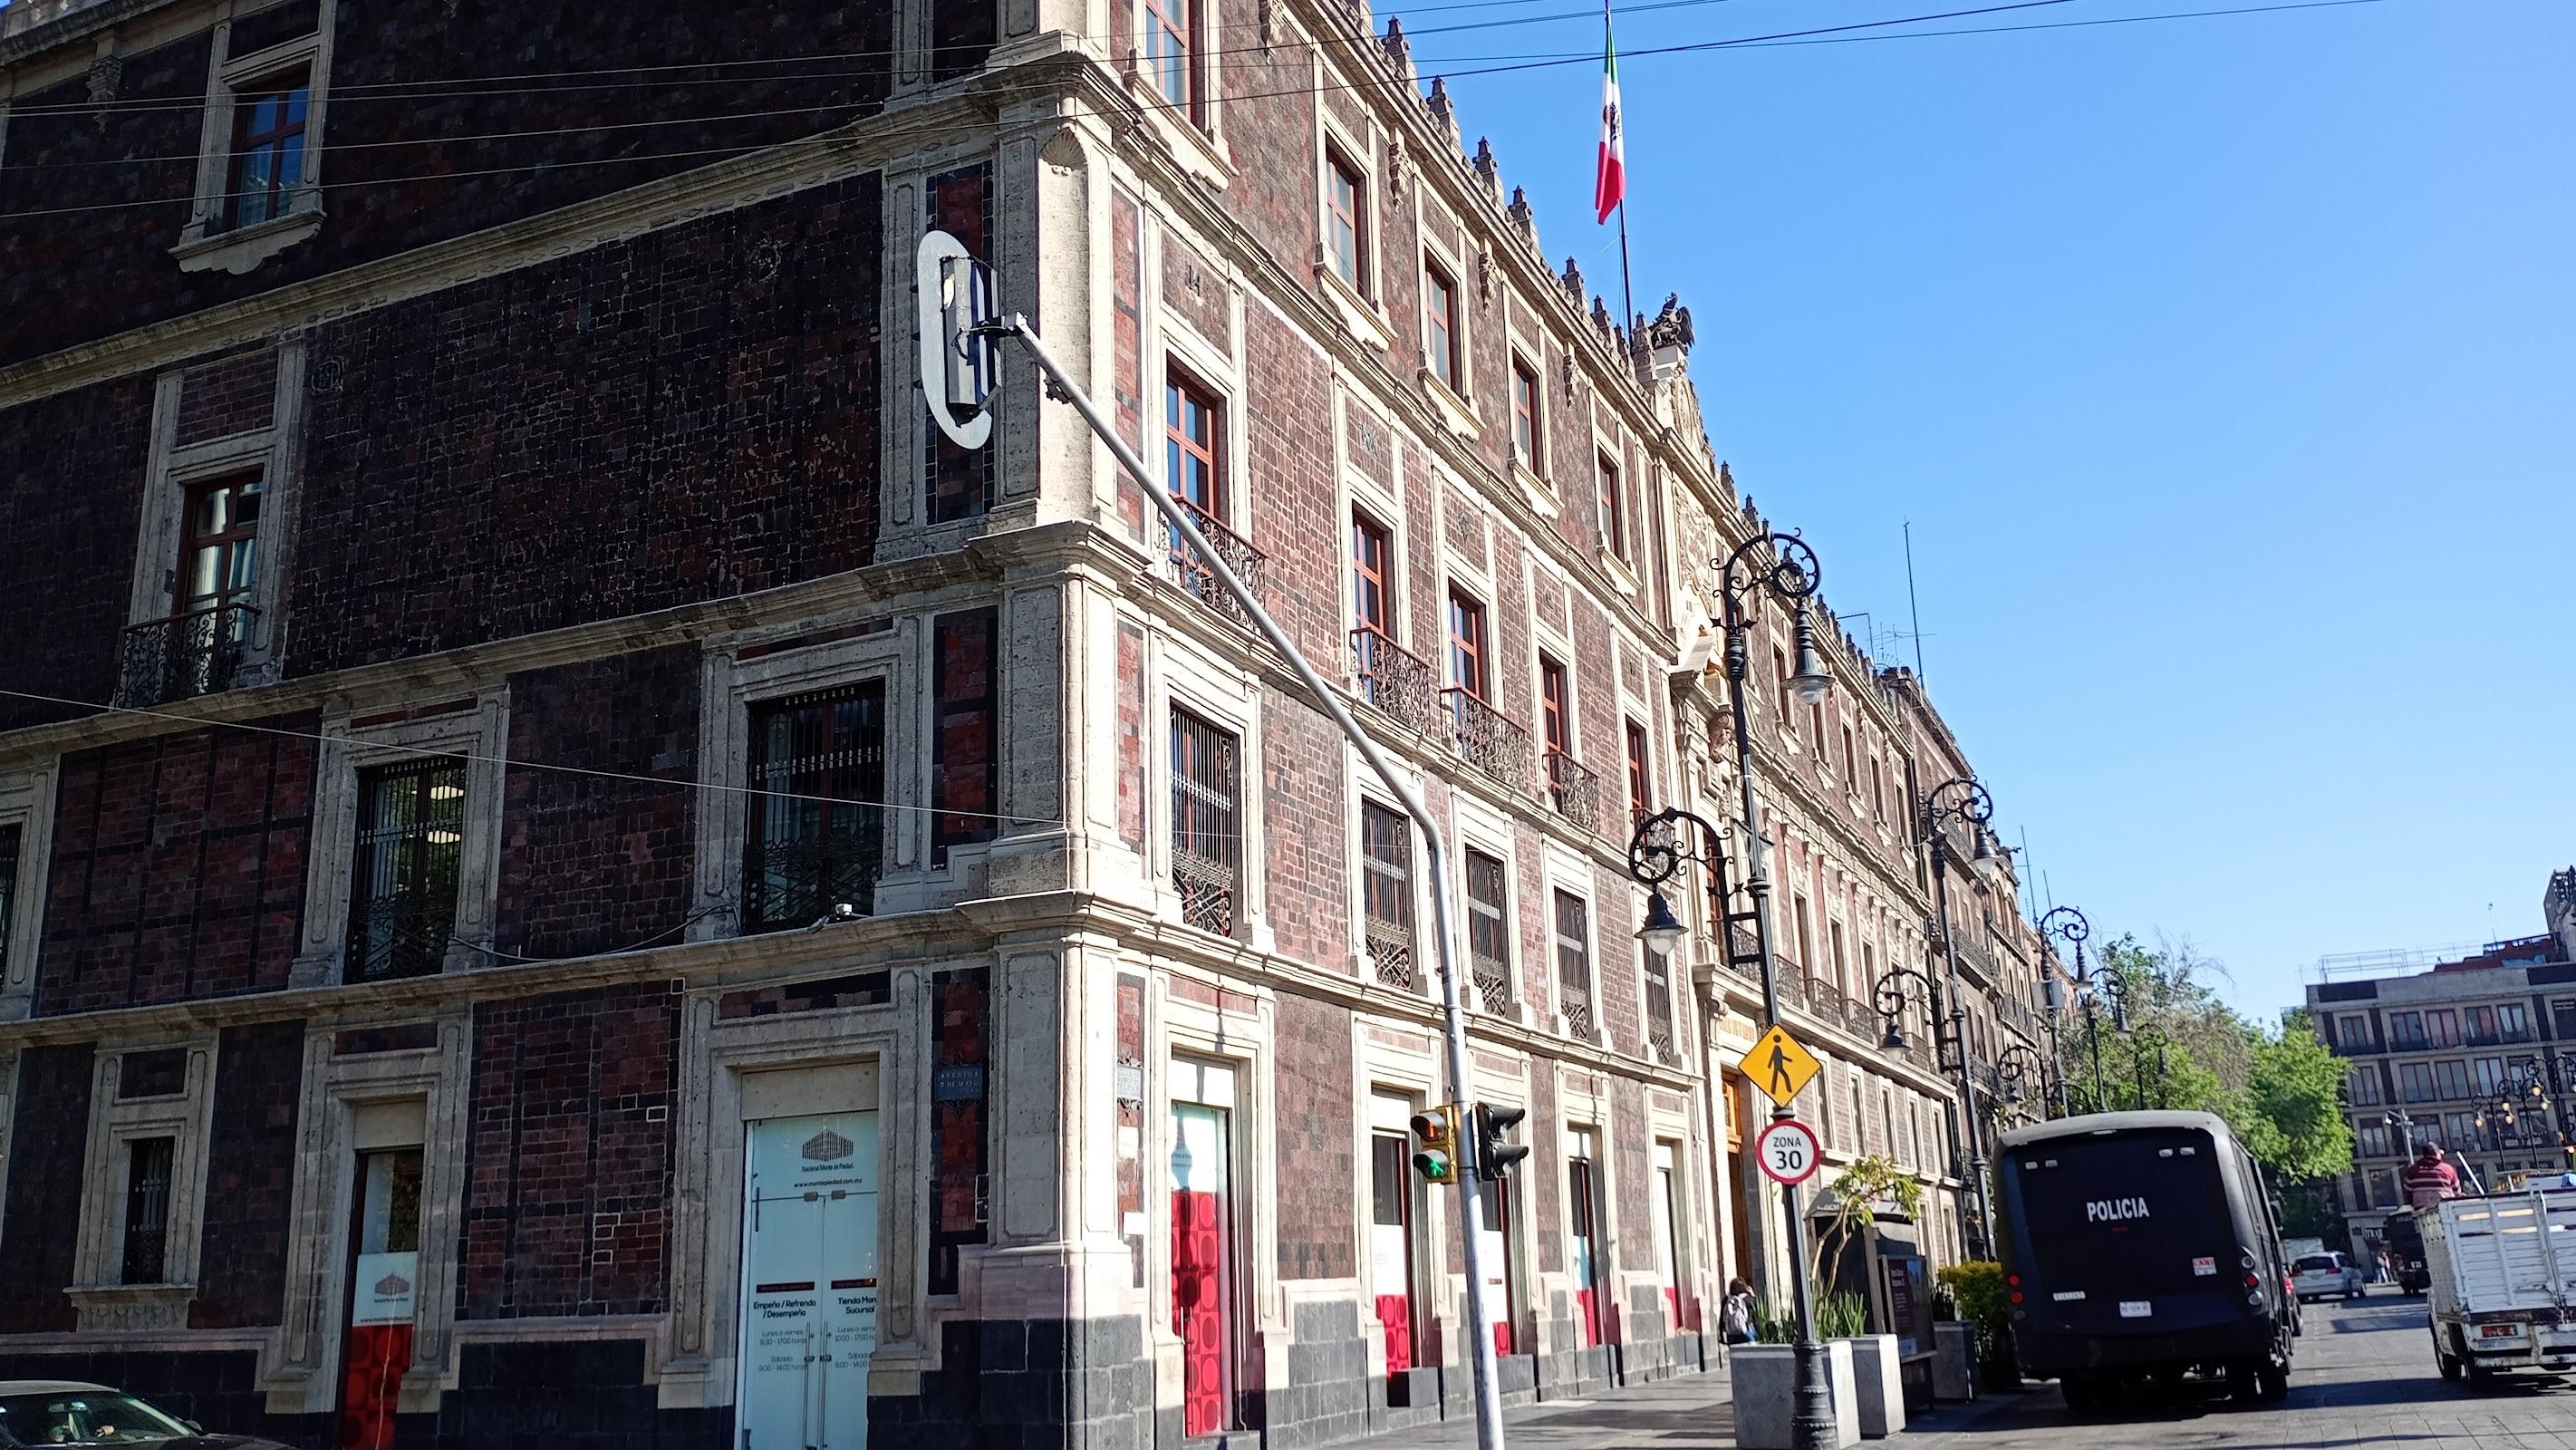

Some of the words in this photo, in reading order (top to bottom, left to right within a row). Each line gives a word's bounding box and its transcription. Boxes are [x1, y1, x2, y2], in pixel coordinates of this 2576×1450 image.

[941, 1071, 979, 1079] AVENIDA
[1773, 1136, 1802, 1147] ZONA
[1775, 1150, 1802, 1170] 30
[2086, 1197, 2150, 1223] POLICIA
[753, 1300, 780, 1310] Empeño
[786, 1299, 816, 1307] Refrendo
[838, 1297, 860, 1305] Tienda
[767, 1309, 806, 1319] Desempeño
[845, 1306, 874, 1314] Sucursal
